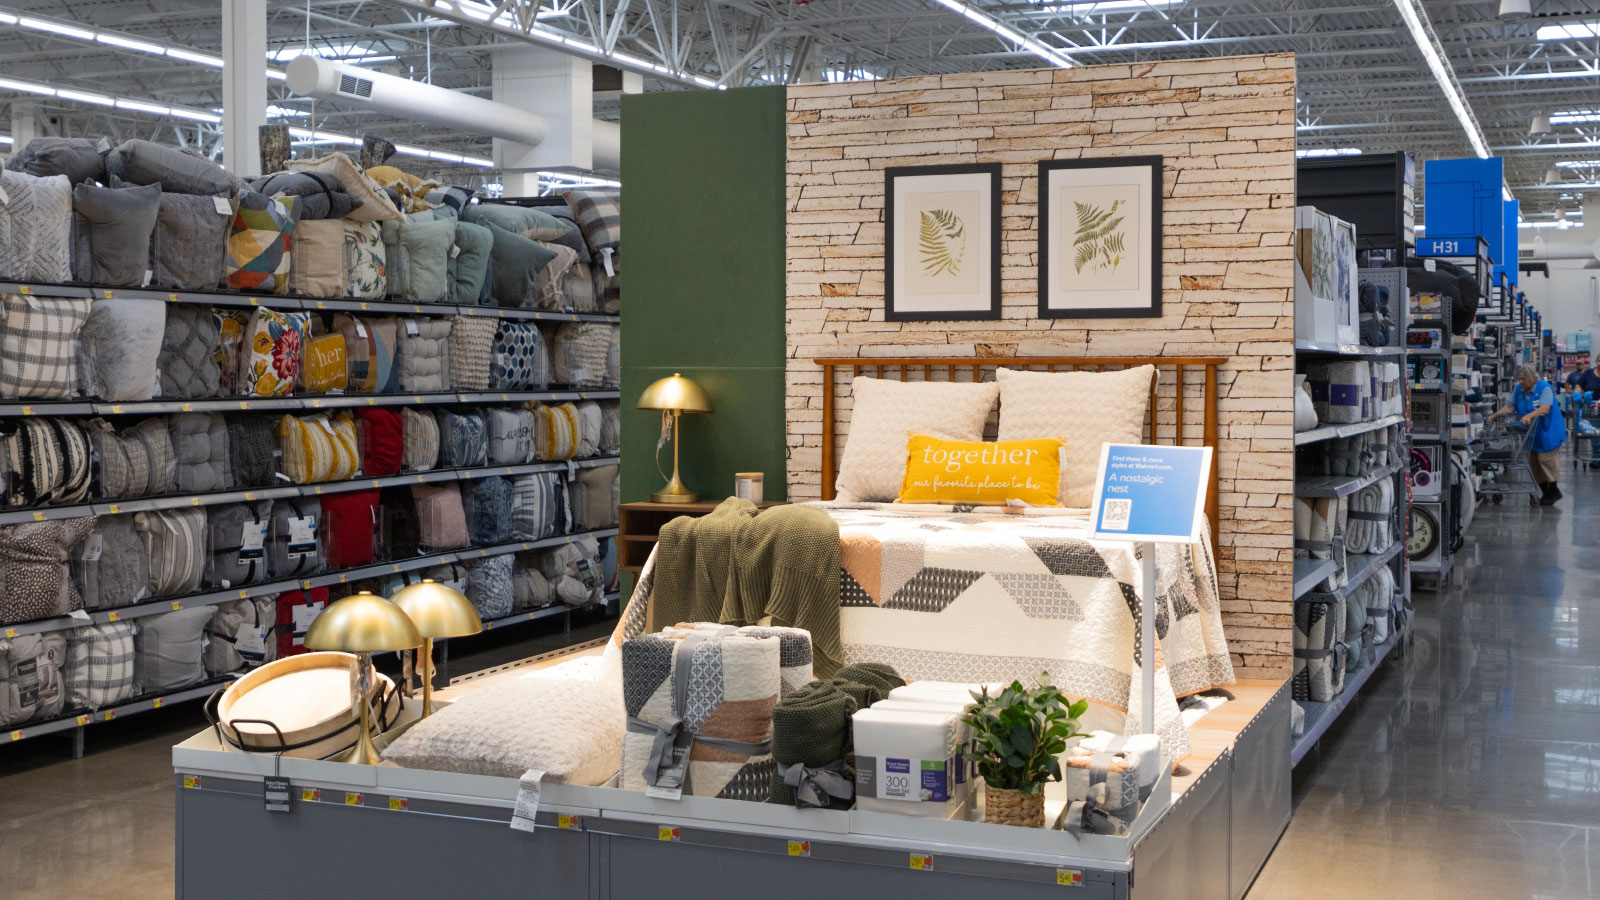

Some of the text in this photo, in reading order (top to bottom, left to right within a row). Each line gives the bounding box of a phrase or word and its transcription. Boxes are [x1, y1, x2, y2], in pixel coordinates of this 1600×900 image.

[1433, 241, 1459, 253] H31
[924, 445, 1039, 472] together
[933, 475, 976, 492] favorite
[976, 476, 1011, 495] place
[1012, 478, 1024, 488] to
[1026, 477, 1040, 490] be
[1108, 473, 1164, 485] A nostalgic
[1108, 485, 1128, 493] nest
[886, 775, 908, 788] 300
